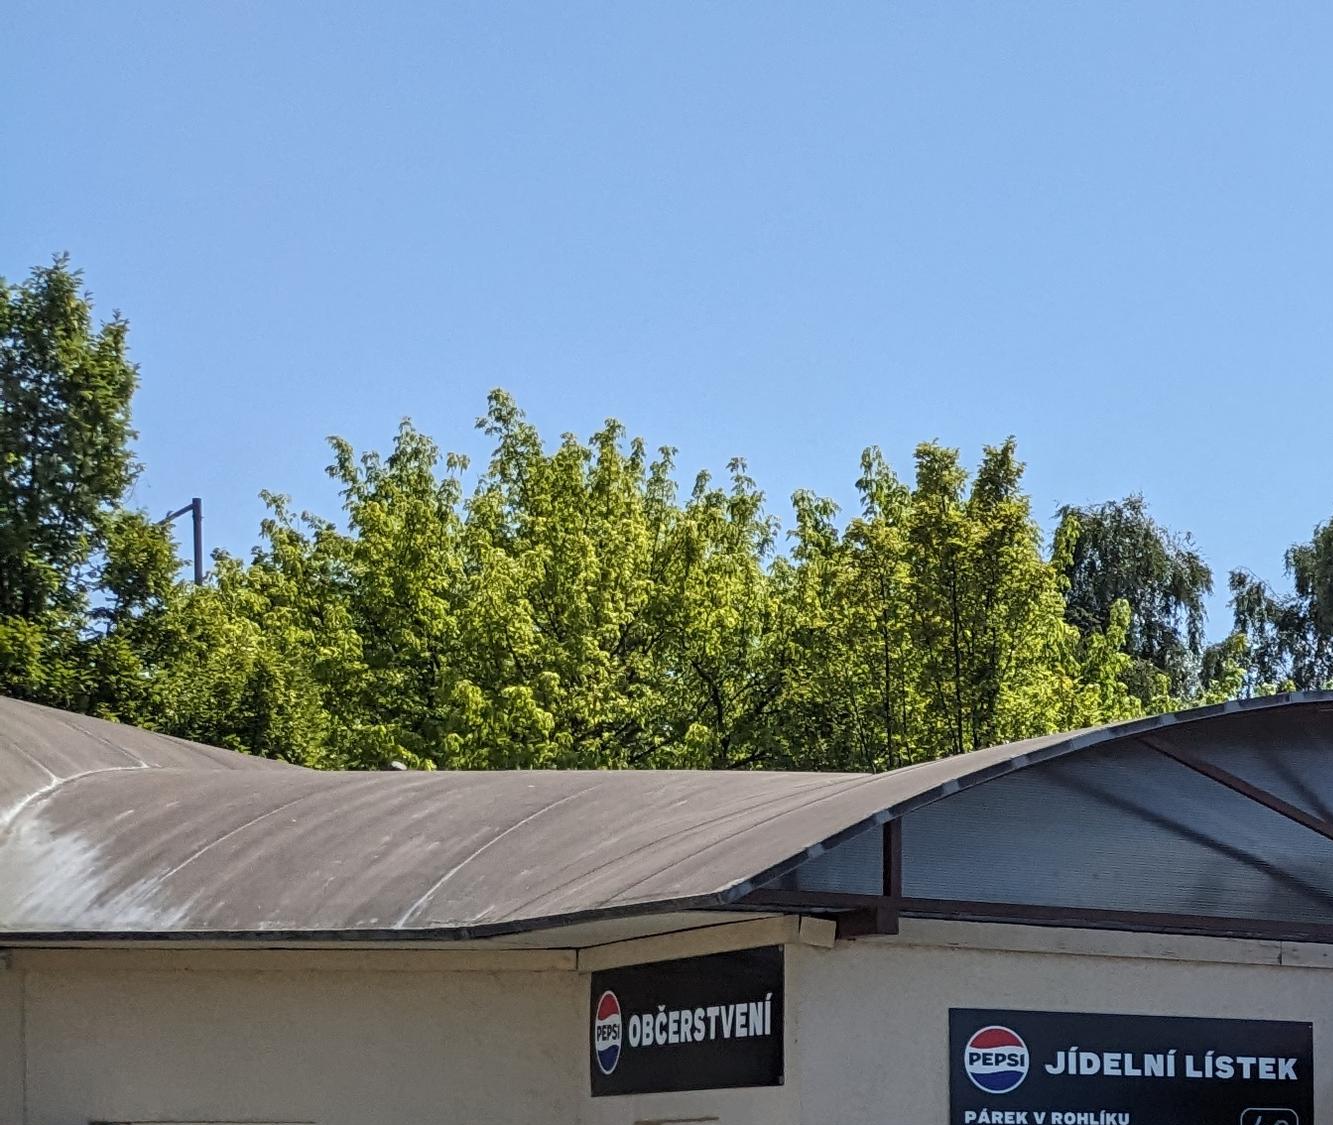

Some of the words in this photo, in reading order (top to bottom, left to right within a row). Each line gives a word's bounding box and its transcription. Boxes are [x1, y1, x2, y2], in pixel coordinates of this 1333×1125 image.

[628, 992, 773, 1048] OBČERSTVENÍ
[597, 1023, 621, 1042] PEPSI
[968, 1051, 1026, 1068] PEPSI
[1044, 1046, 1177, 1077] JÍDELNÍ
[1185, 1050, 1299, 1080] LÍSTEK
[964, 1108, 1028, 1125] PÁREK
[1033, 1111, 1046, 1125] V
[1051, 1110, 1130, 1125] ROHLÍKU
